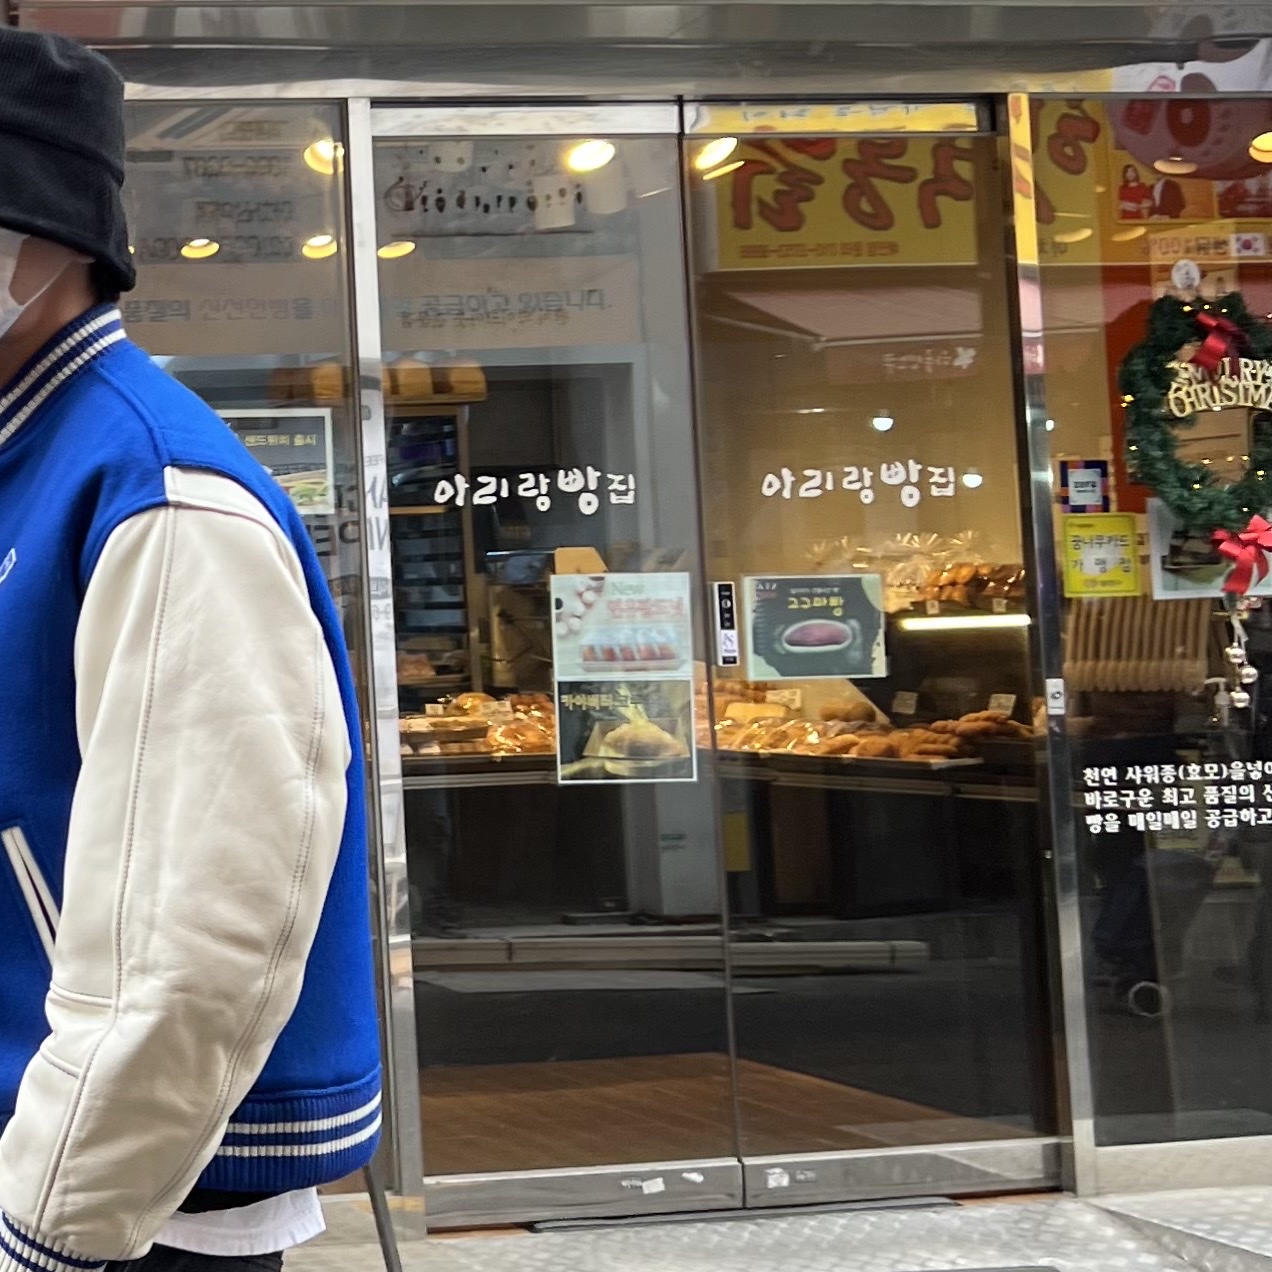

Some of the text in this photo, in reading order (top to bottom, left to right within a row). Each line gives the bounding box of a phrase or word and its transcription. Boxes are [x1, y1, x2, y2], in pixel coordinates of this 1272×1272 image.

[434, 465, 637, 515] 아리랑빵집
[761, 459, 956, 508] 아리랑빵집
[1082, 766, 1118, 787] 천연
[1084, 787, 1154, 810] 바로구운
[1162, 787, 1197, 807] 최고
[1203, 784, 1255, 804] 품질의
[1085, 812, 1121, 834] 빵을
[1128, 809, 1197, 831] 매일매일
